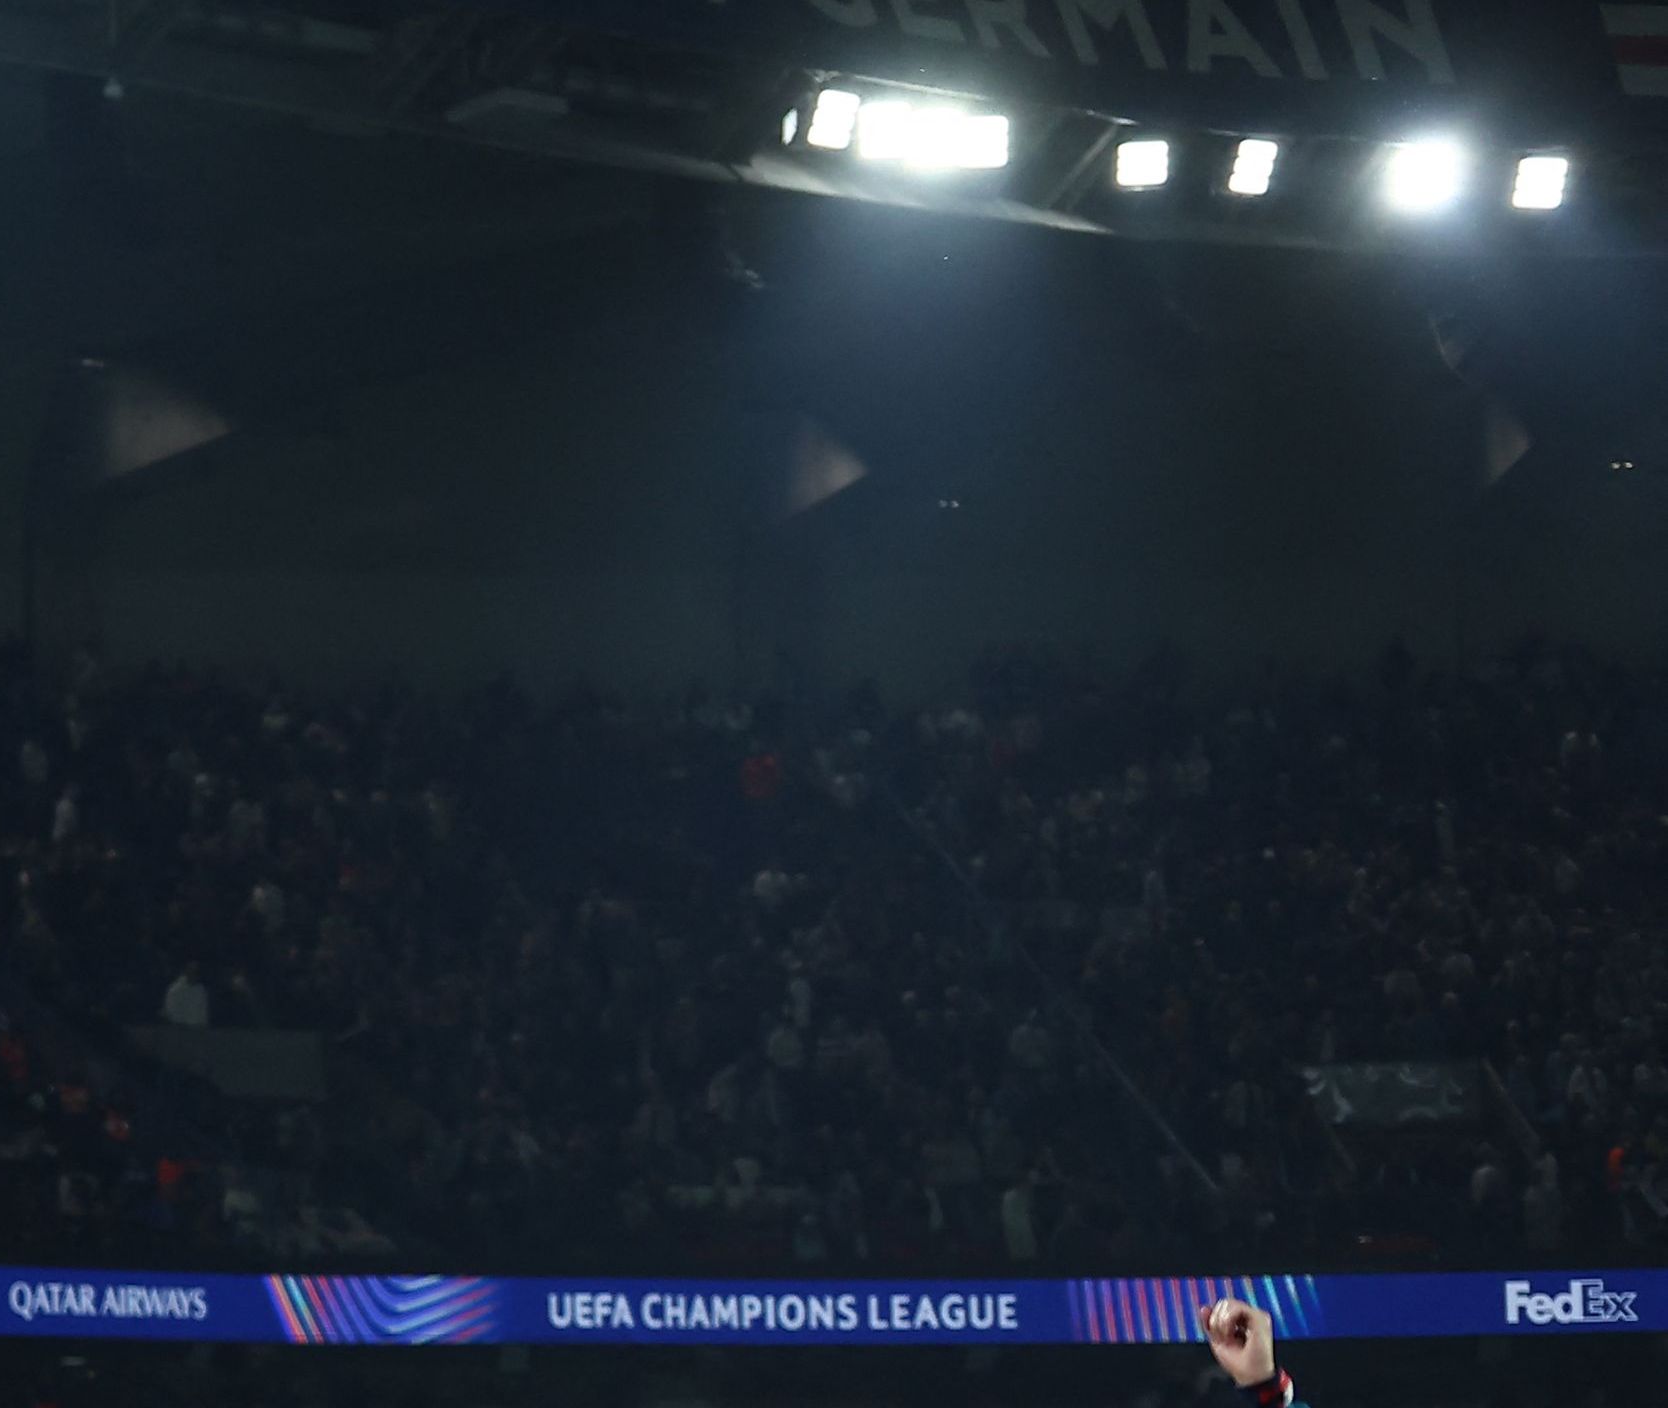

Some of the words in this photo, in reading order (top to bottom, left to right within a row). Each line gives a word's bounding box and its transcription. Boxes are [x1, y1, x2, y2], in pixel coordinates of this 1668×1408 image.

[814, 0, 1457, 84] RMAIN
[9, 1282, 96, 1320] QATAR
[102, 1285, 207, 1320] AIRWAYS
[548, 1292, 634, 1329] UEFA
[641, 1292, 859, 1330] CHAMPIONS
[868, 1293, 1018, 1330] LEAGUE
[1505, 1278, 1639, 1324] FedEx
